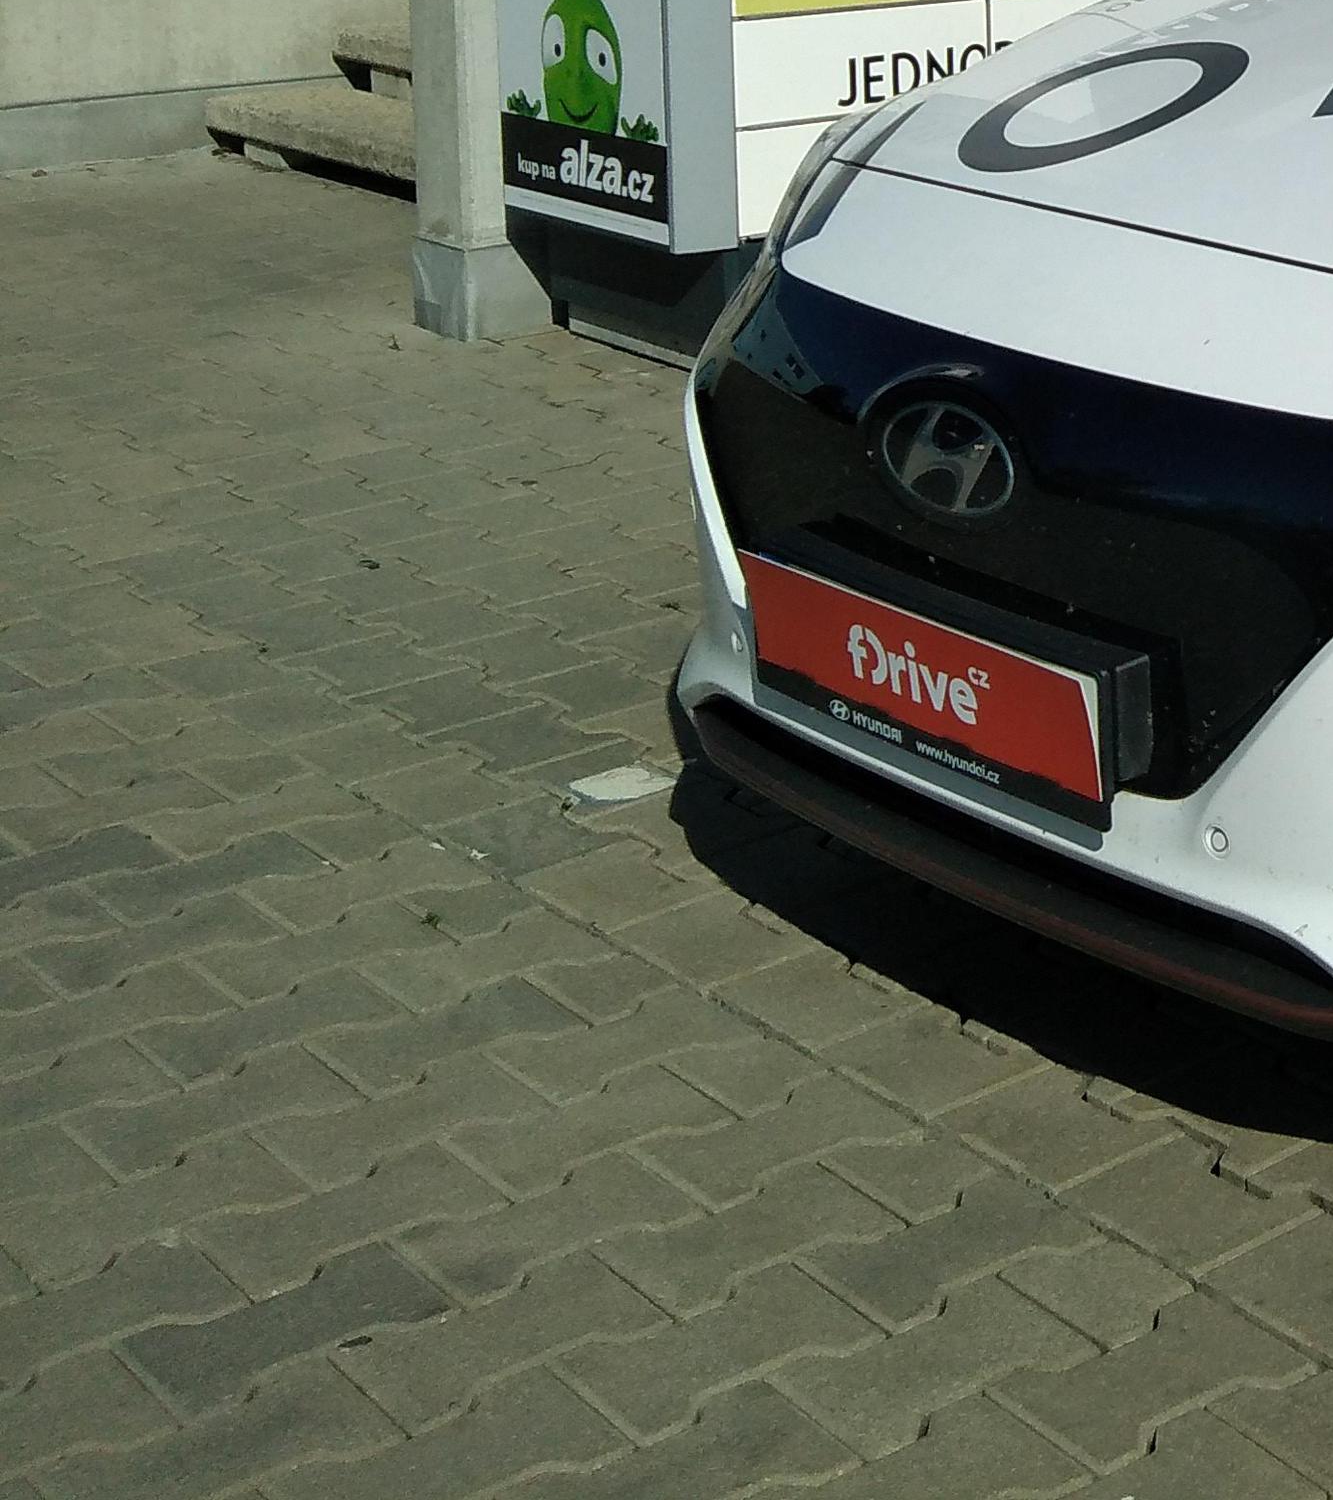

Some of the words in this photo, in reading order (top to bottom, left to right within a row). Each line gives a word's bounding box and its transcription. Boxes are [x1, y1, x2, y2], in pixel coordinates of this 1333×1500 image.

[517, 152, 540, 180] kup
[541, 164, 556, 180] na
[560, 138, 655, 204] alza.cz
[852, 709, 902, 744] HYUNDAI
